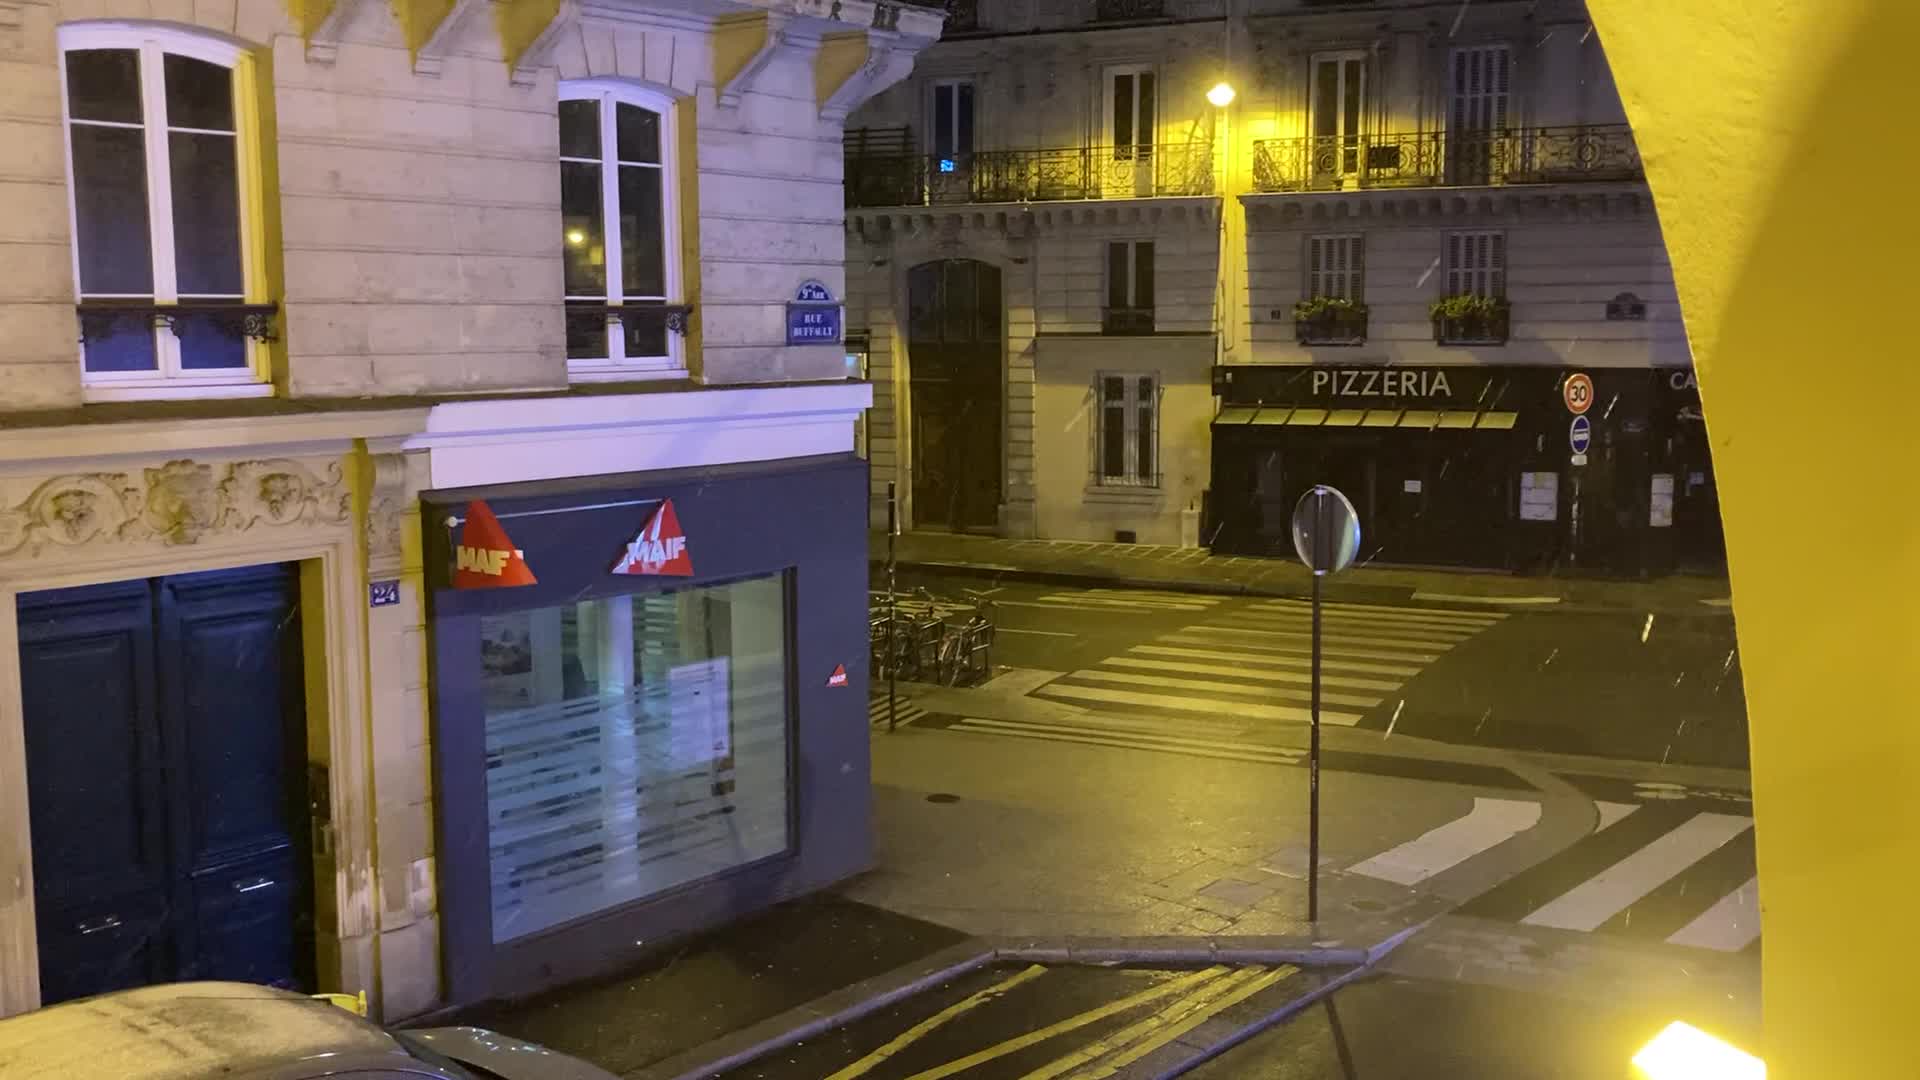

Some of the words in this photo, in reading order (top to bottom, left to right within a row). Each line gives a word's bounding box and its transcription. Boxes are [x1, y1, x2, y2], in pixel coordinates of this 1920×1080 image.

[804, 314, 822, 324] RUE
[1312, 370, 1452, 397] PIZZERIA
[1571, 385, 1587, 402] 30
[626, 536, 686, 566] MAIF
